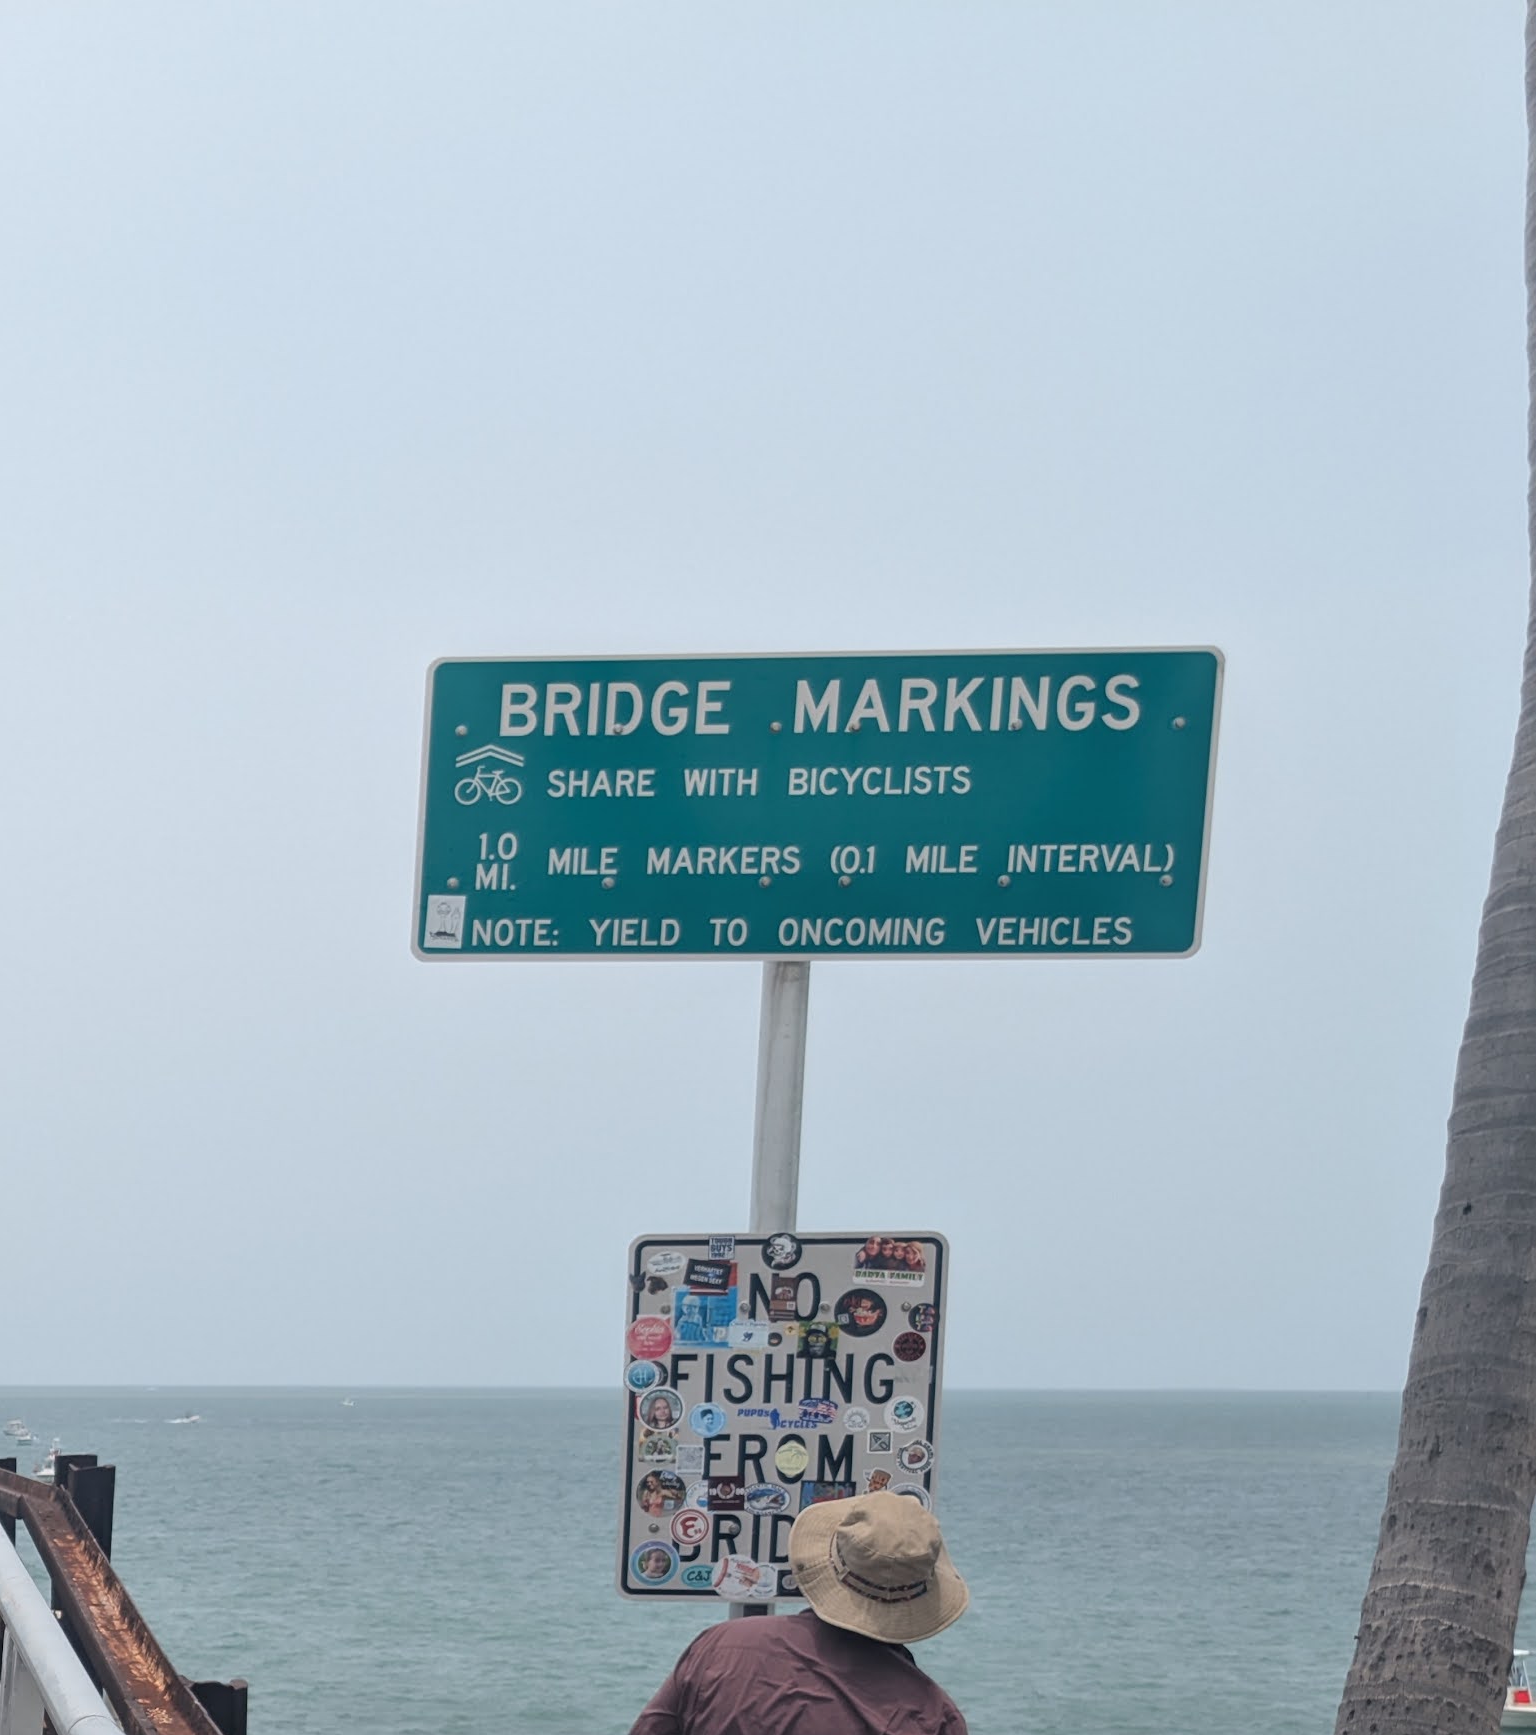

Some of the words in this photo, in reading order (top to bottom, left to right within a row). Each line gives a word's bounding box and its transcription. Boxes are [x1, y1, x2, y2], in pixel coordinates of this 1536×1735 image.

[500, 681, 730, 736] BRIDGE
[794, 675, 1140, 733] MARKINGS
[548, 770, 655, 797] SHARE
[685, 769, 757, 796] WITH
[789, 766, 970, 795] BICYCLISTS
[480, 833, 517, 860] 1.0
[549, 848, 617, 874] MILE
[648, 846, 800, 874] MARKERS
[831, 846, 875, 873] (0.1
[906, 846, 977, 872] MILE
[1008, 845, 1174, 872] INTERVAL)
[476, 864, 515, 890] MI.
[473, 919, 558, 946] NOTE:
[590, 919, 679, 945] YIELD
[710, 919, 747, 946] TO
[779, 918, 944, 945] ONCOMING
[977, 917, 1131, 945] VEHICLES
[749, 1272, 821, 1322] NO
[670, 1353, 895, 1405] FISHING
[686, 1571, 712, 1582] C&J
